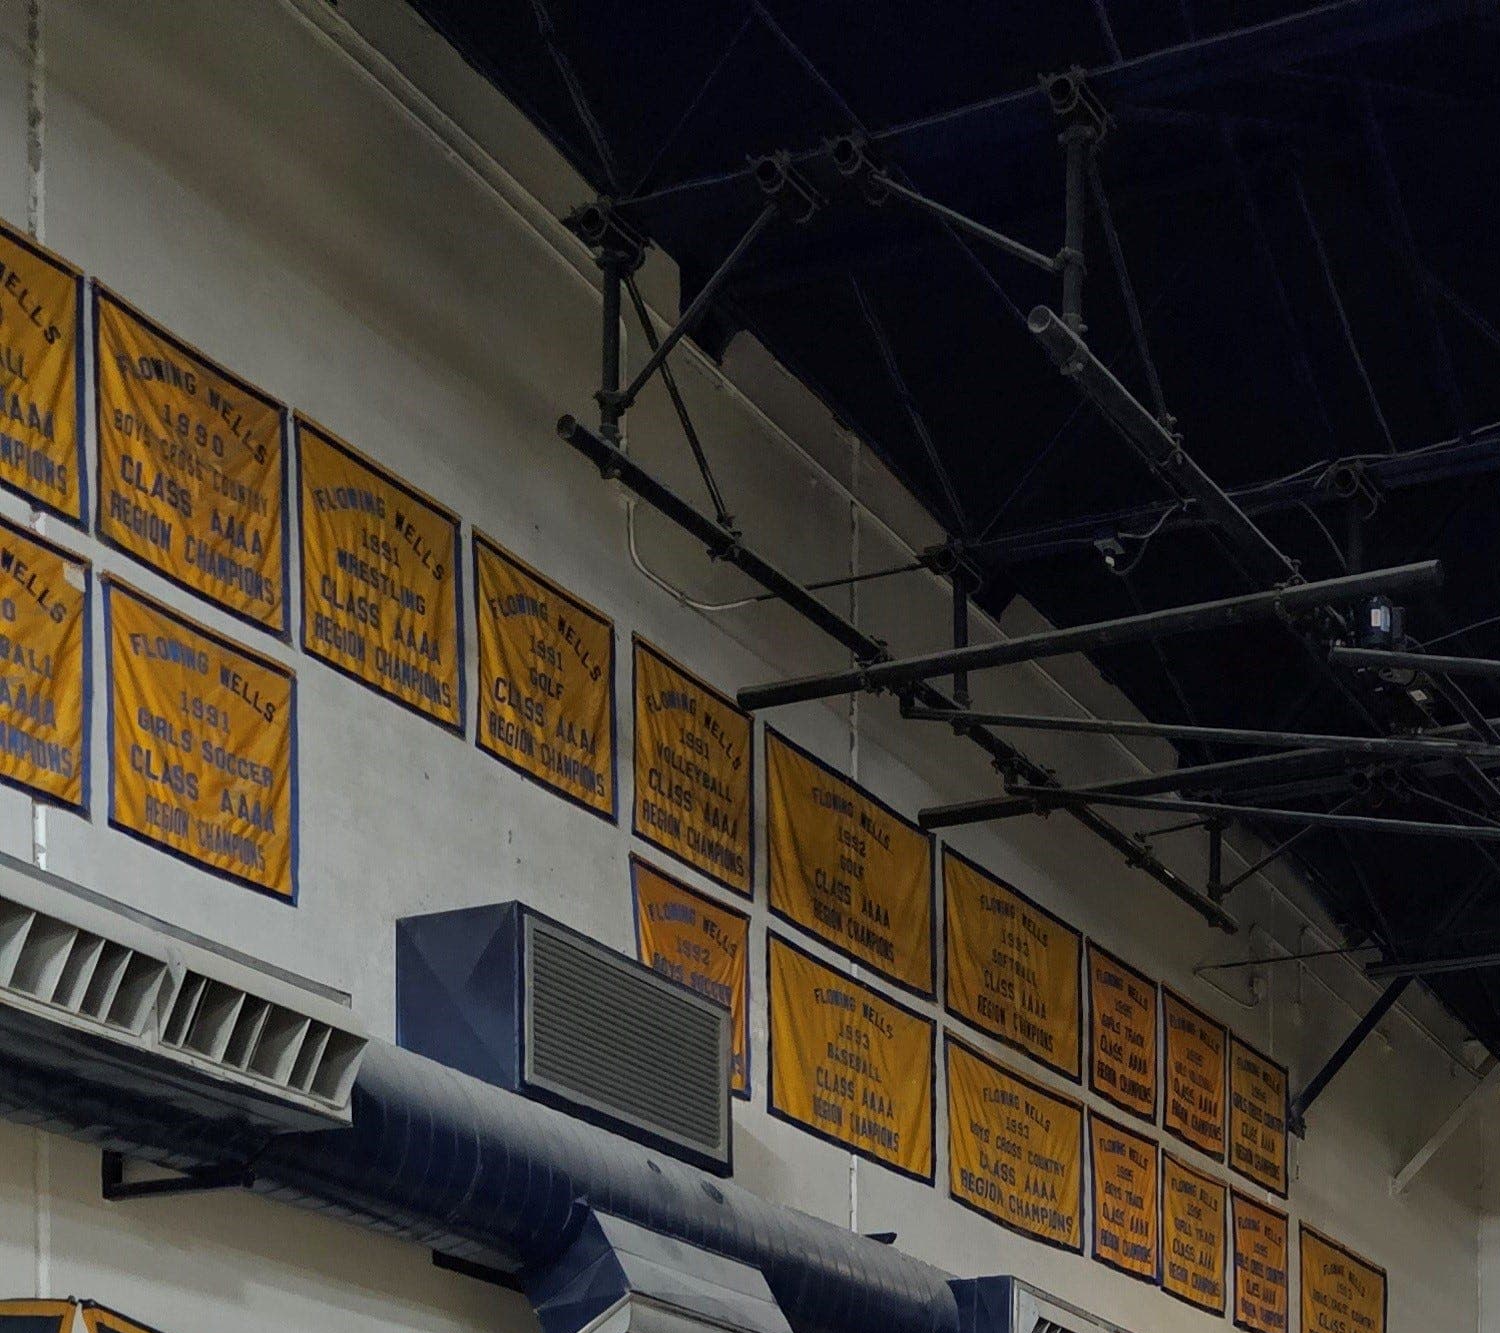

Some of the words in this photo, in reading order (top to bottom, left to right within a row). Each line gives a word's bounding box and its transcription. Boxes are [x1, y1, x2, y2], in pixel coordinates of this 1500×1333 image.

[116, 352, 198, 395] FLOWING
[207, 389, 269, 465] WELLS
[120, 455, 191, 519] CLASS
[212, 508, 262, 556] AAAA
[313, 487, 386, 519] FLOWING
[394, 511, 445, 581] WELLS
[110, 489, 172, 552] REGION
[184, 534, 275, 604] CHAMPIONS
[337, 549, 426, 616] WRESTLING
[313, 612, 366, 662] REGION
[375, 648, 452, 709] CHAMPIONS
[320, 574, 381, 630] CLASS
[393, 623, 441, 666] AAAA
[488, 595, 549, 621] FLOWING
[557, 615, 601, 683] WELLS
[130, 631, 209, 675] FLOWING
[219, 664, 276, 723] WELLS
[494, 676, 549, 728] CLASS
[555, 720, 598, 755] AAAA
[529, 667, 565, 700] GOLF
[138, 707, 193, 753] GIRLS
[202, 740, 273, 788] SOCCER
[489, 710, 536, 757] REGION
[539, 741, 605, 798] CHAMPIONS
[656, 742, 733, 804] VOLLEYBALL
[130, 744, 199, 802] CLASS
[220, 788, 276, 835] AAAA
[145, 795, 190, 839] REGION
[198, 816, 266, 872] CHAMPIONS
[828, 1042, 882, 1083] BASEBALL
[983, 1088, 1020, 1110] FLOWING
[1025, 1101, 1050, 1133] WELLS
[961, 1168, 1003, 1207] REGION
[1009, 1194, 1073, 1234] CHAMPIONS
[980, 1150, 1015, 1186] CLASS
[1025, 1174, 1056, 1202] AAAA
[1028, 1150, 1065, 1177] COUNTRY
